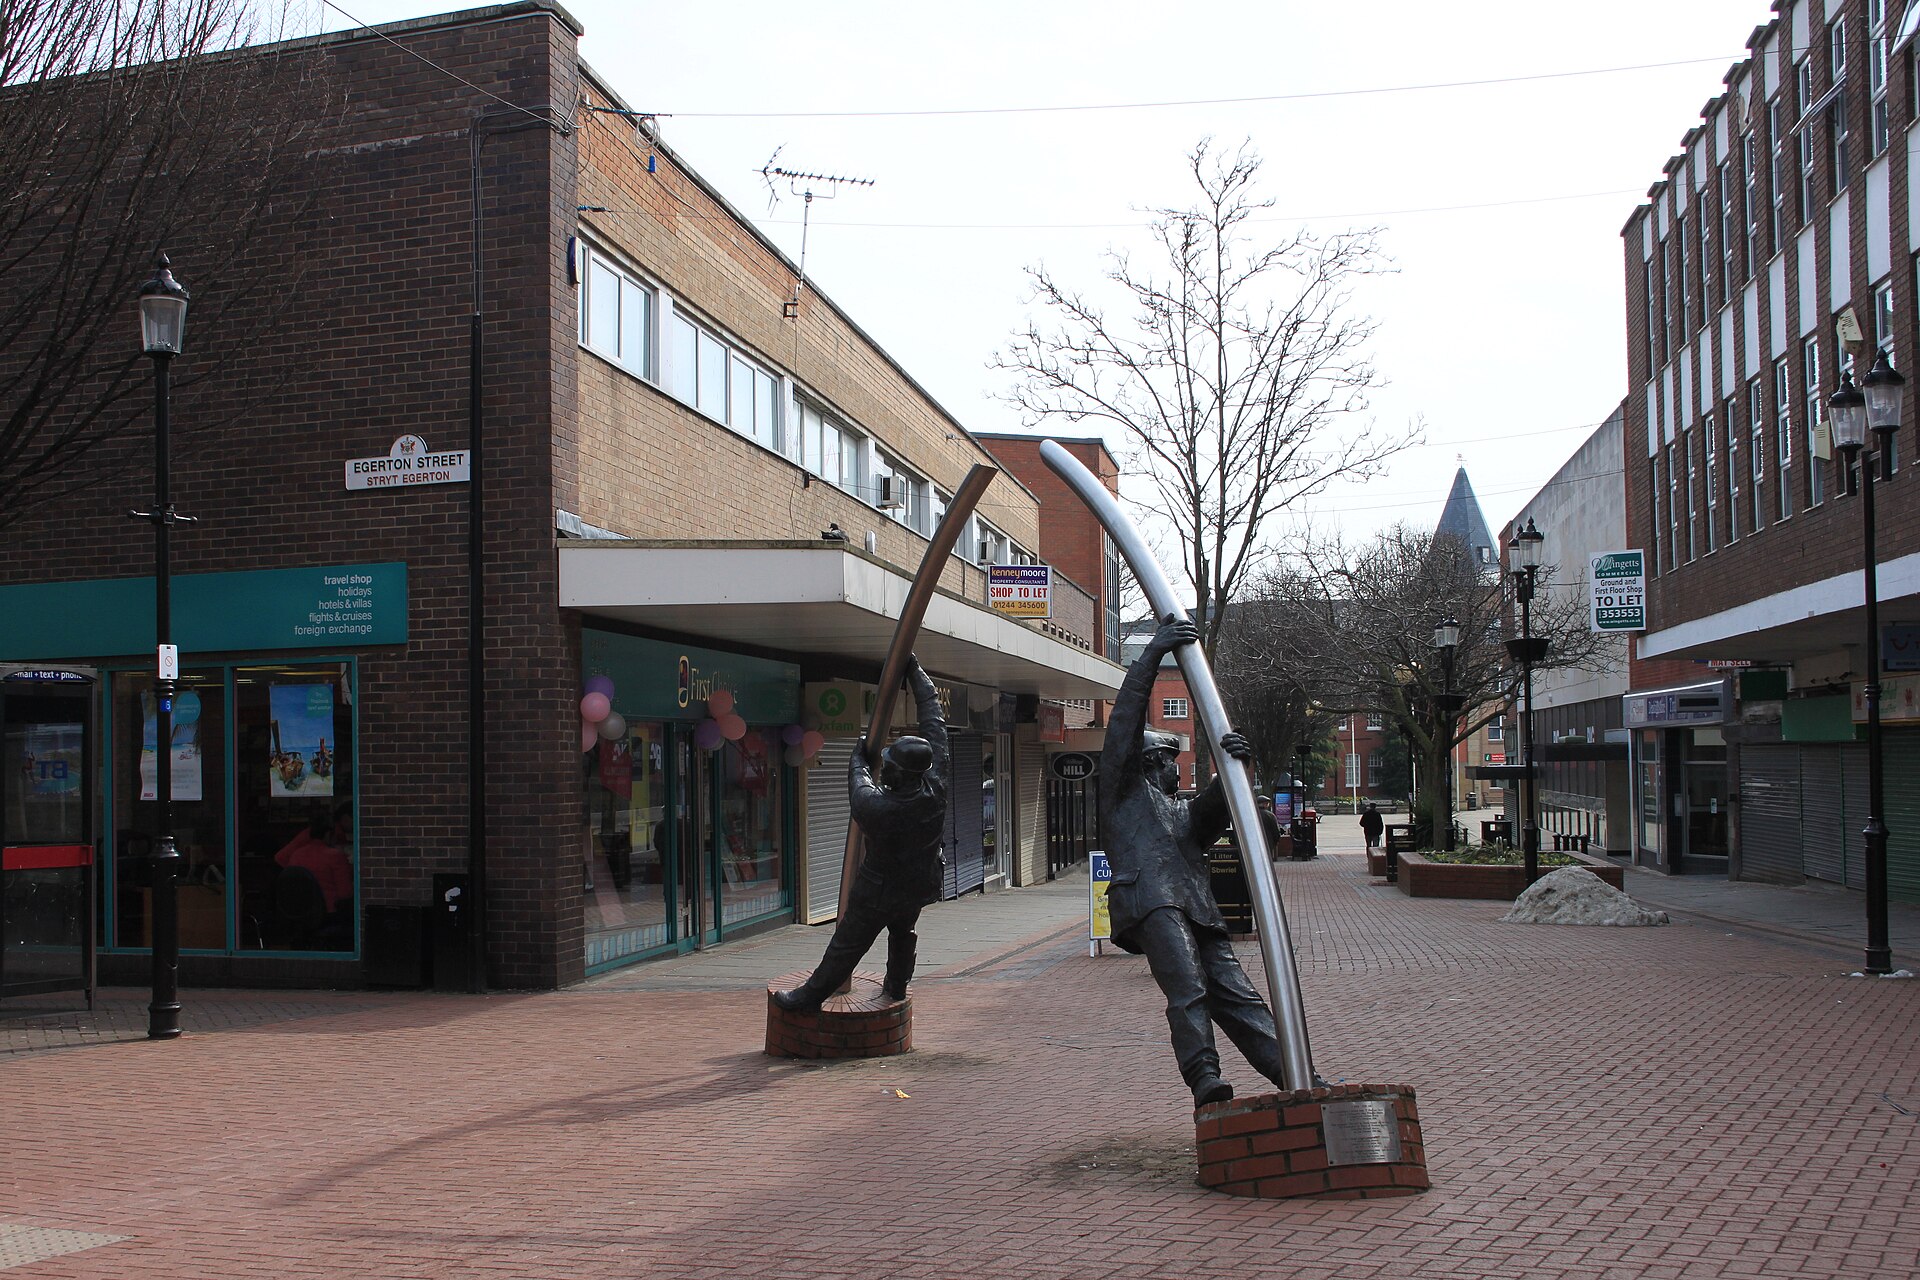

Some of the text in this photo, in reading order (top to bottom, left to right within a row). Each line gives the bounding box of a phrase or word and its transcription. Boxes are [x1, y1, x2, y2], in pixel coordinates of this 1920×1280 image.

[354, 453, 464, 473] EGERTON STREET
[367, 470, 450, 486] STRYT EGERTON
[1591, 556, 1639, 571] Wingetts
[324, 574, 373, 585] travel shop
[338, 587, 373, 597] holidays
[990, 587, 1048, 598] SHOP TO LET
[1609, 586, 1626, 594] Floor
[1626, 585, 1642, 594] Shop
[318, 599, 373, 610] hotels & villas
[993, 601, 1015, 609] 01244
[1595, 594, 1643, 607] TO LET
[309, 611, 373, 624] flights & cruises
[1601, 608, 1641, 619] 353553
[294, 624, 373, 637] foreign exchange
[39, 670, 54, 679] text
[690, 667, 711, 701] First
[1063, 765, 1085, 776] HILL
